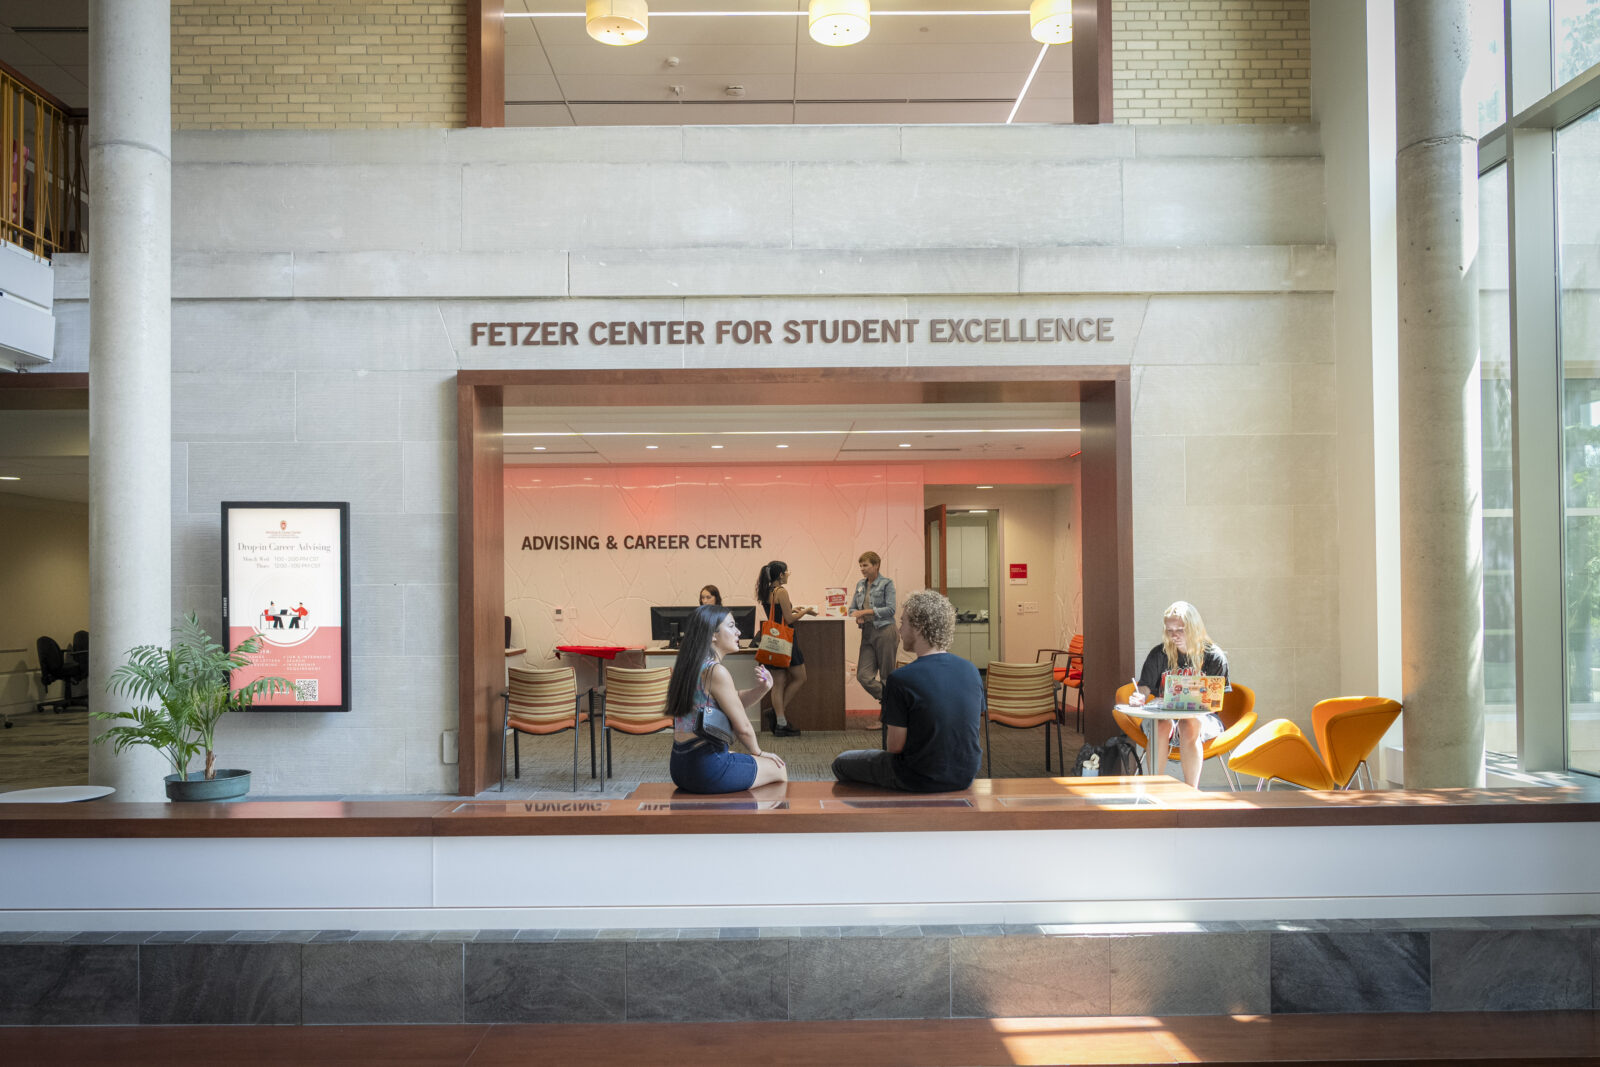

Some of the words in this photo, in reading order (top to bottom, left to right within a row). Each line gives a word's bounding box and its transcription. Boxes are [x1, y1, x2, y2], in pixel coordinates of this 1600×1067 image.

[471, 322, 579, 346] FETZER
[588, 321, 705, 345] CENTER
[716, 320, 773, 345] FOR
[783, 319, 919, 344] STUDENT
[930, 318, 1114, 343] EXCELLENCE
[269, 542, 295, 551] Career
[298, 542, 331, 553] Advising
[521, 536, 600, 550] ADVISING
[606, 536, 618, 550] &
[623, 535, 690, 549] CAREER
[696, 534, 762, 549] CENTER
